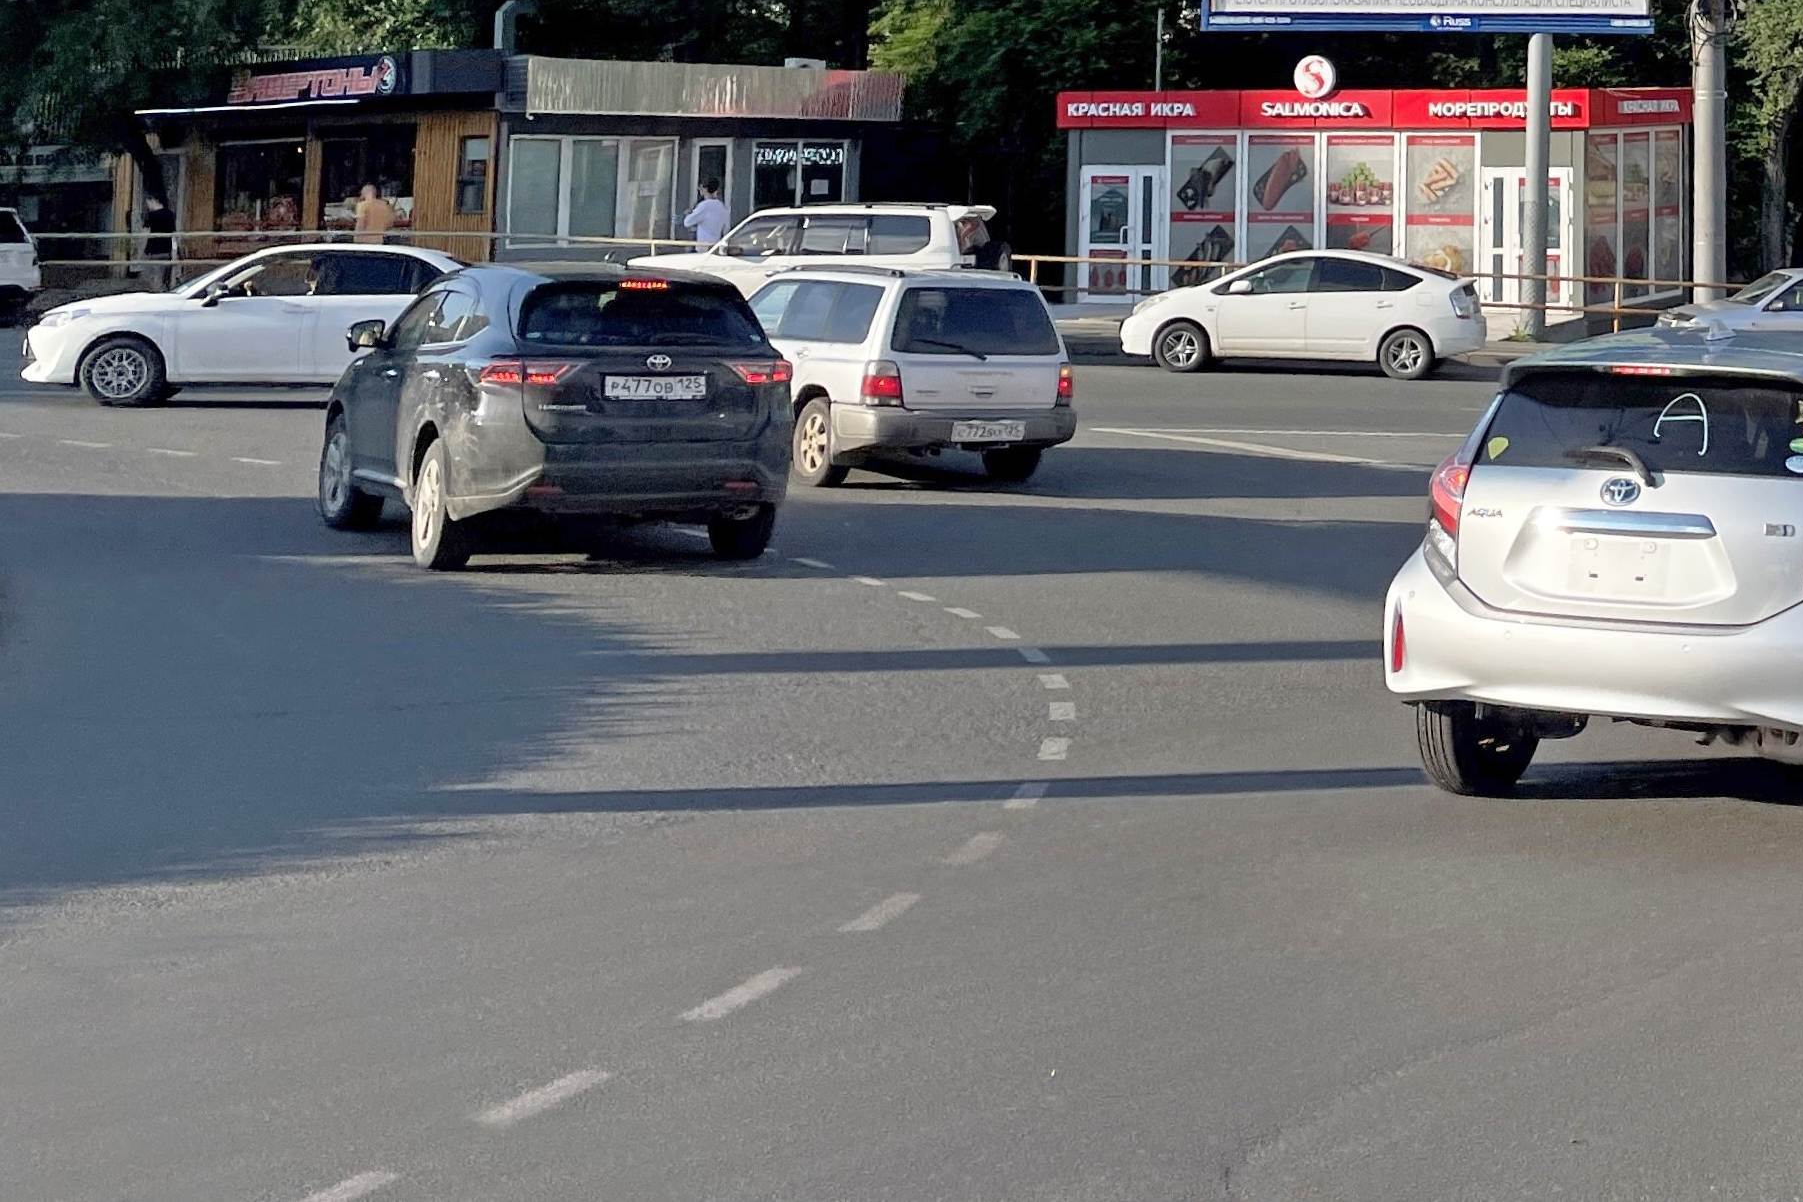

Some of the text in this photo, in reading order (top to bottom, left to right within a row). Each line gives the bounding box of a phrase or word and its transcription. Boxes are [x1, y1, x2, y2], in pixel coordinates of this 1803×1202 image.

[1067, 103, 1195, 117] КРАСНАЯ ИКРА
[1261, 101, 1363, 117] SALMONICA
[1428, 101, 1572, 118] МОРЕПРОДТЫ
